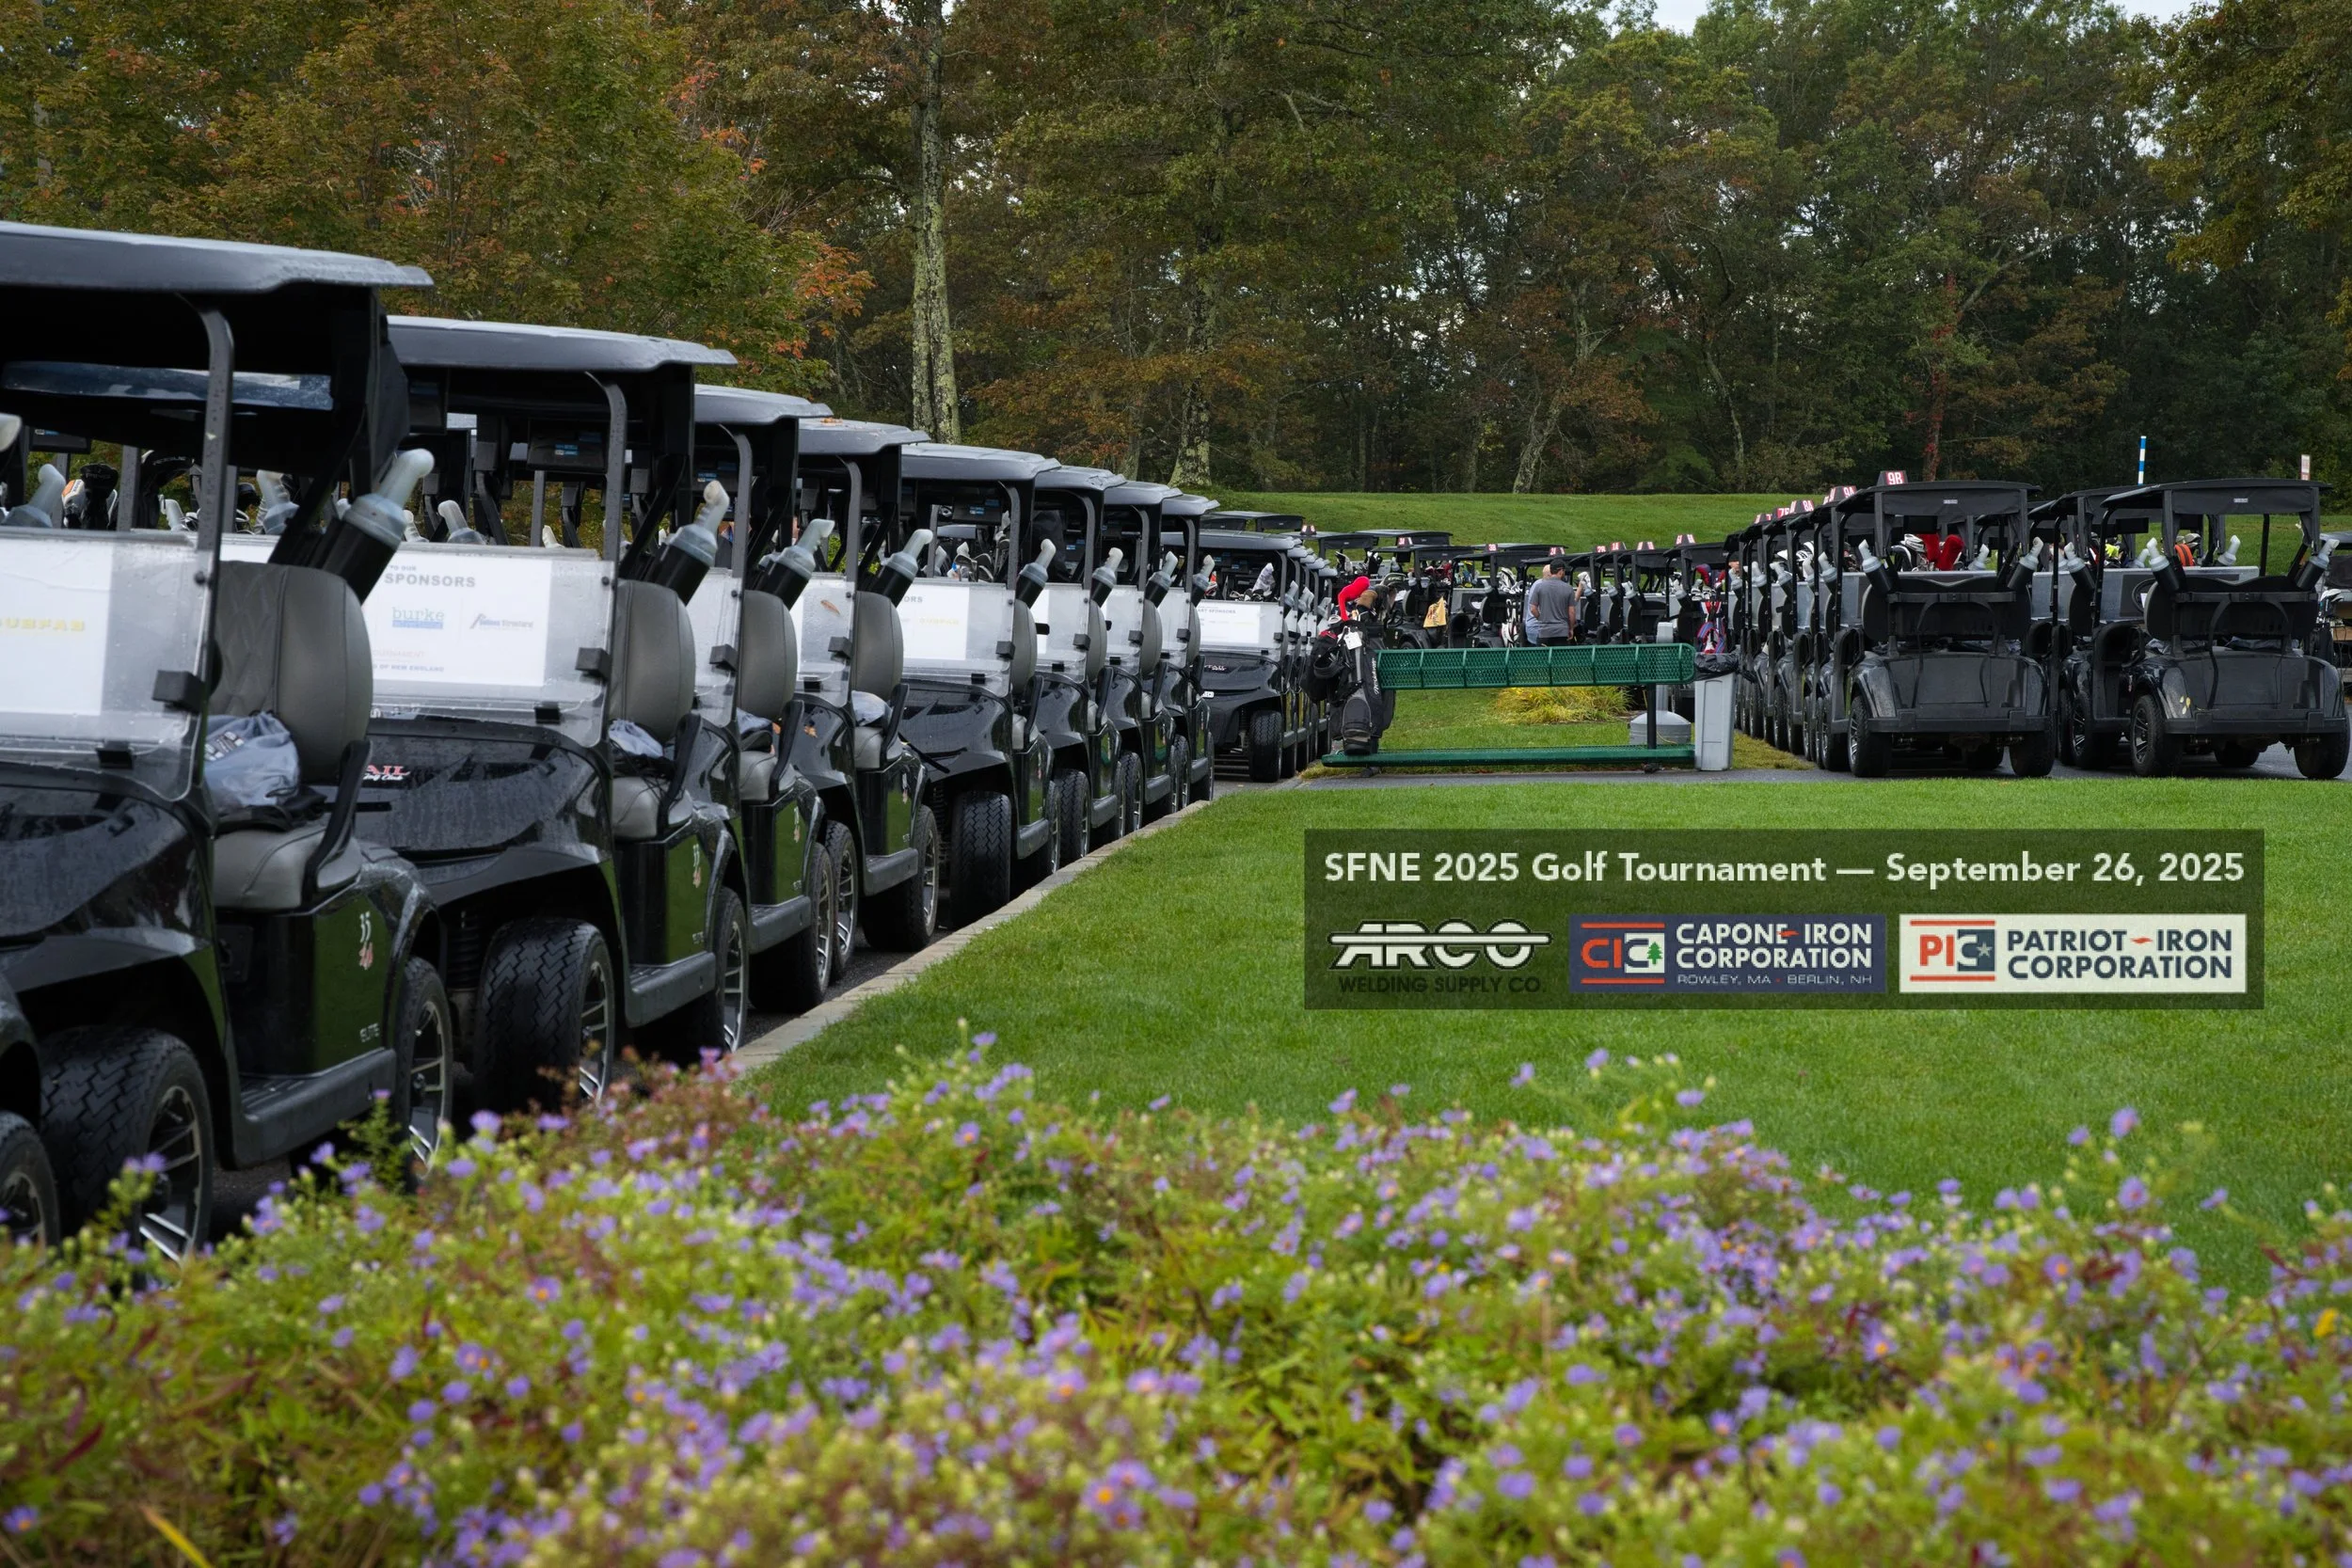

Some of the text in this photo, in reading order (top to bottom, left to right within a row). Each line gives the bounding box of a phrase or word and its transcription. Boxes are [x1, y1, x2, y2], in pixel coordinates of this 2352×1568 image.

[1887, 472, 1902, 485] 9B
[1843, 486, 1855, 499] 9A
[1802, 499, 1815, 513] 8A
[384, 573, 476, 588] SPONSORS
[391, 607, 445, 622] burke
